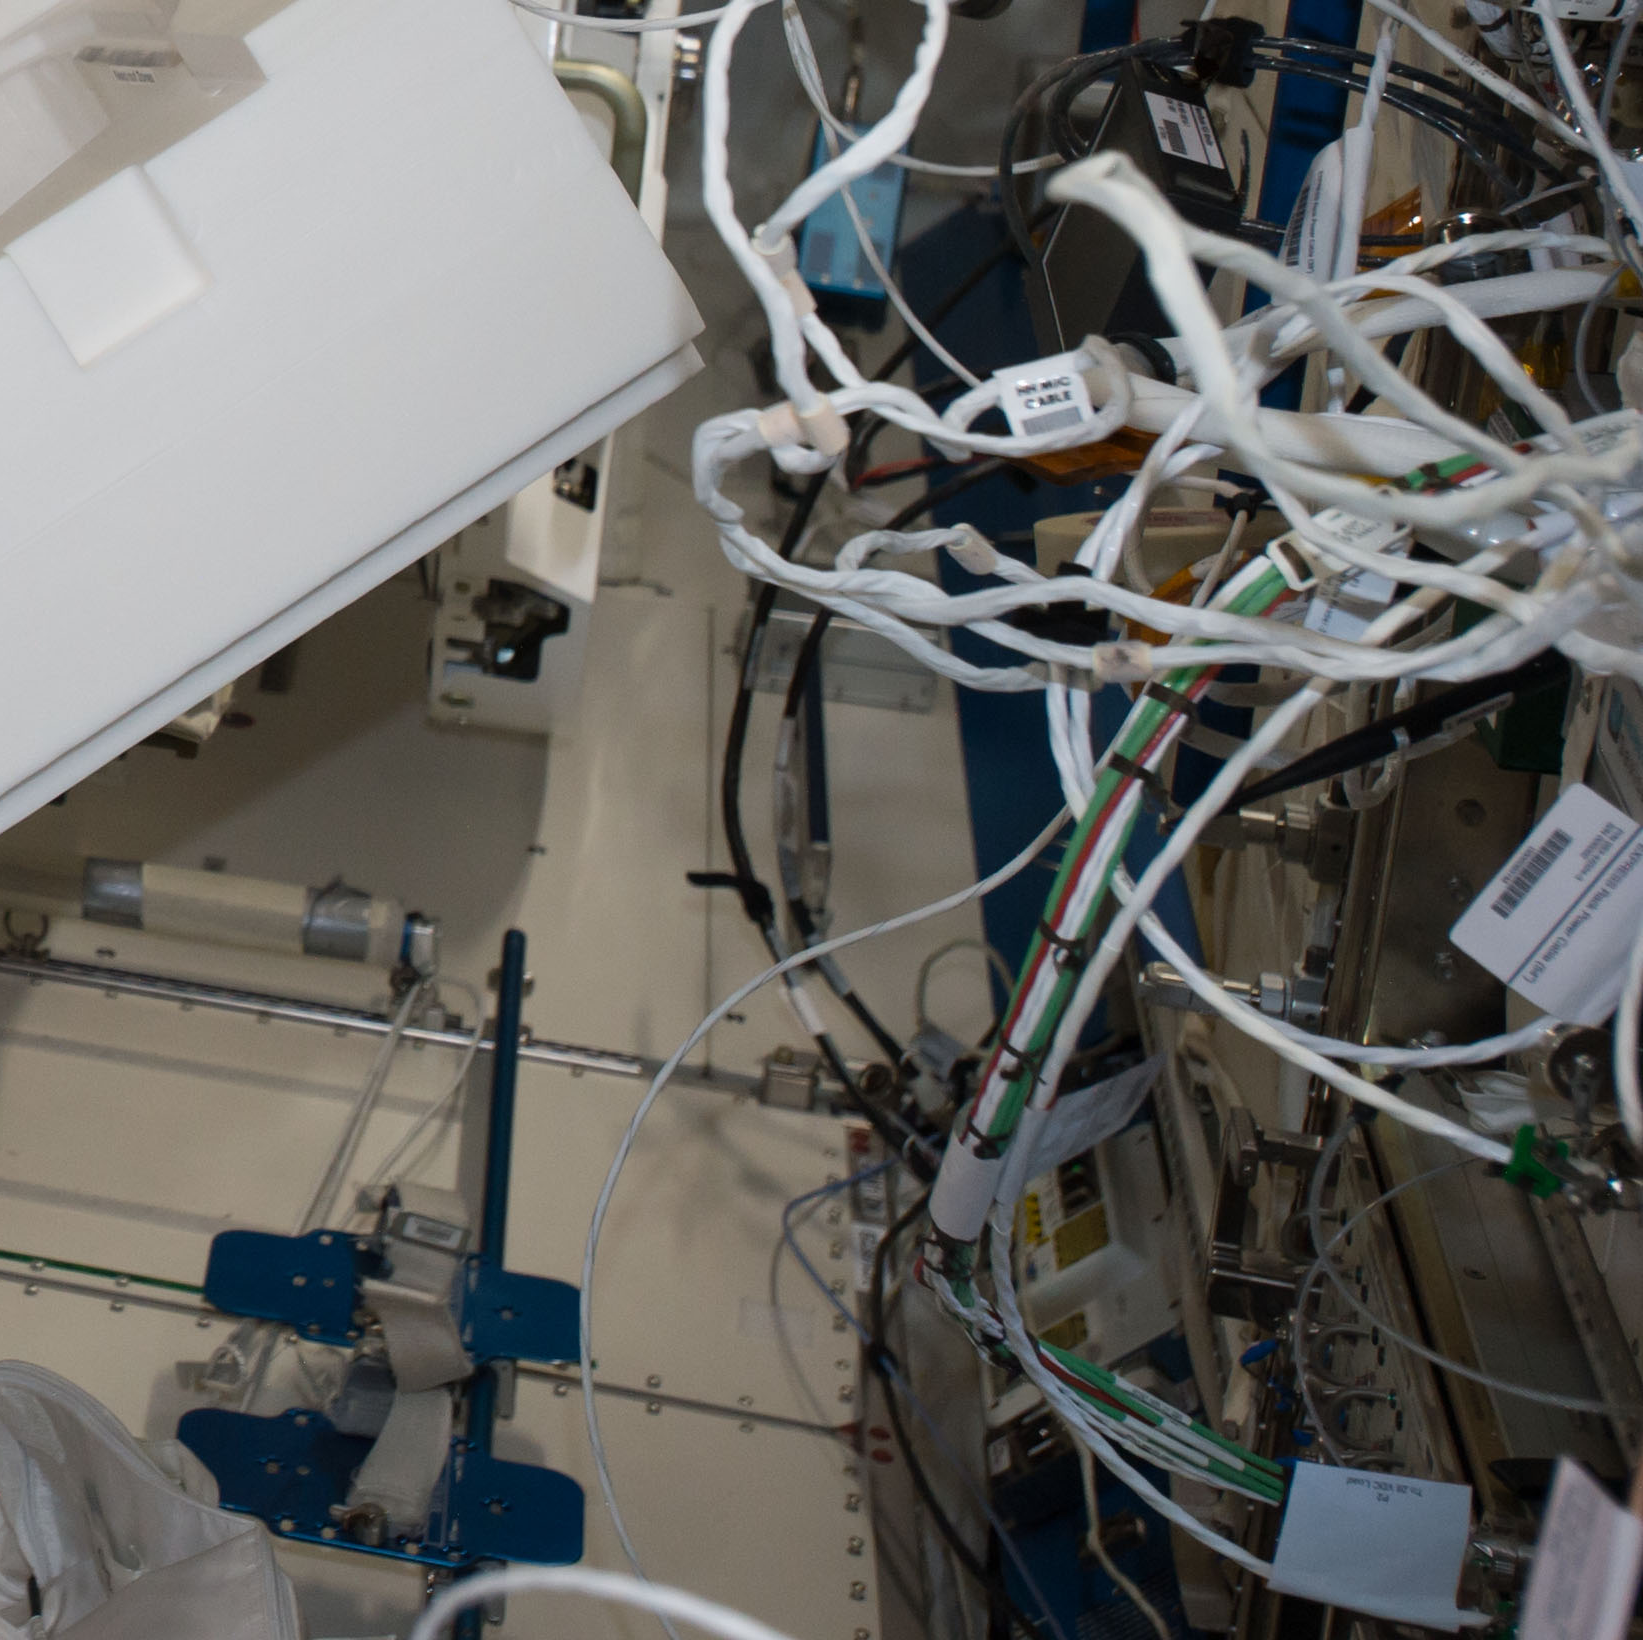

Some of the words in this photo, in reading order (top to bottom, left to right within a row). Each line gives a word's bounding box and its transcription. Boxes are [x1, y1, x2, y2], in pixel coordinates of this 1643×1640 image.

[1024, 391, 1072, 409] CABLE
[1565, 911, 1591, 937] Power
[1543, 936, 1569, 962] Cable
